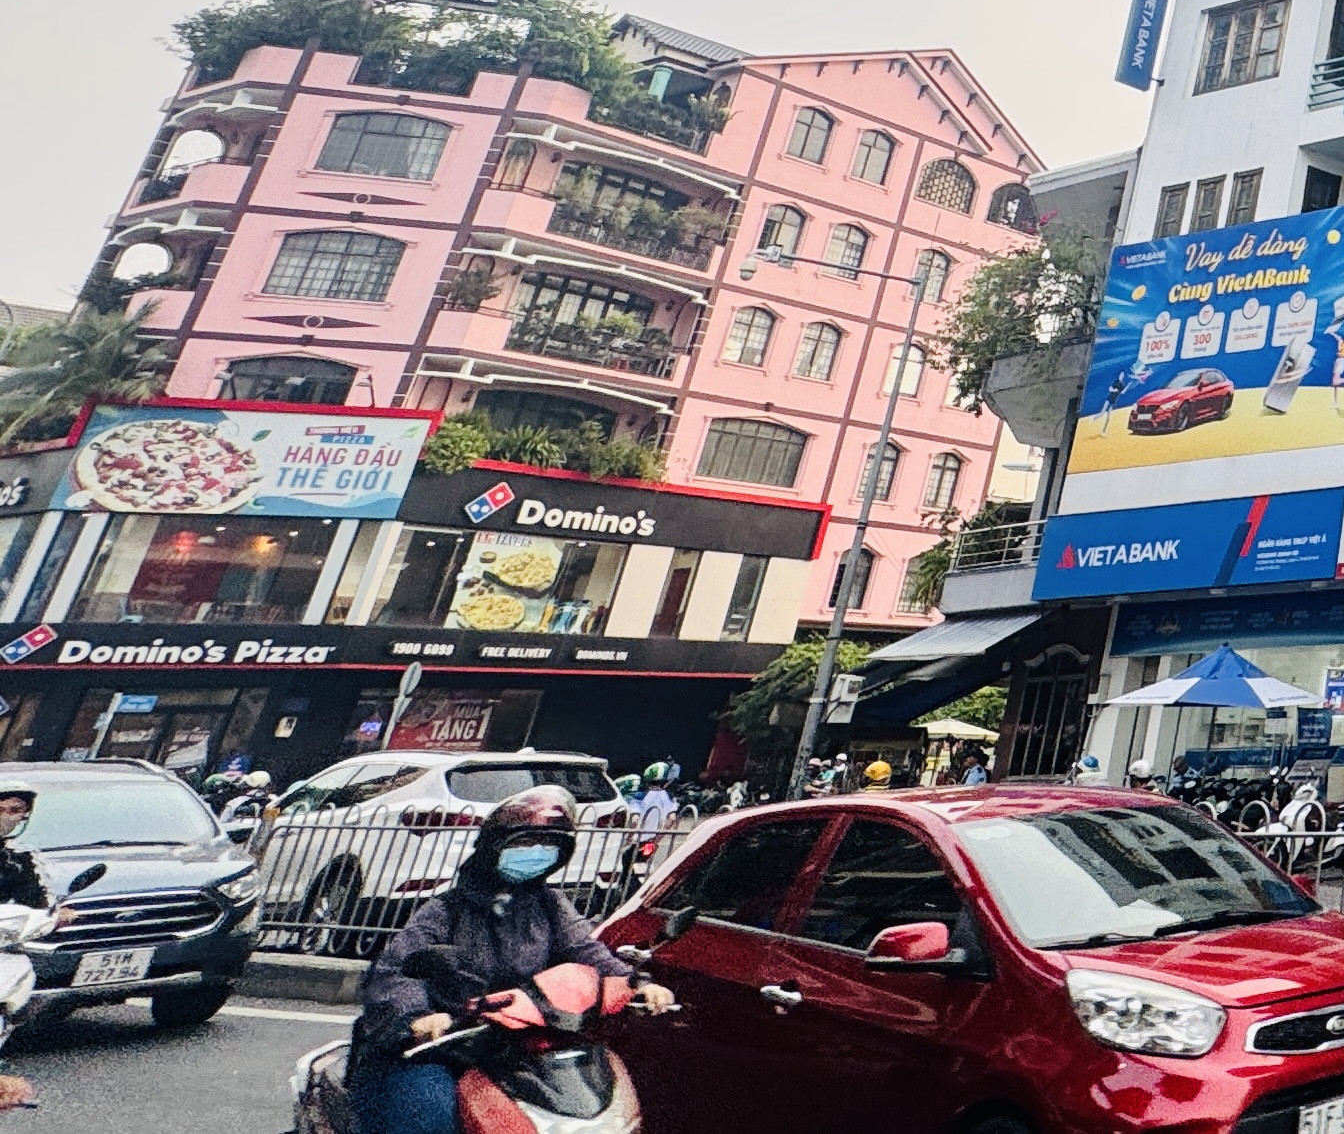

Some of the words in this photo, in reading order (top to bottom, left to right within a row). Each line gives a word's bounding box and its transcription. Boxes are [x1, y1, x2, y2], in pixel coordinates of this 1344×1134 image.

[1186, 243, 1224, 272] Vay
[1228, 233, 1254, 261] dễ
[1256, 228, 1309, 261] dàng
[1168, 279, 1212, 304] Cùng
[1216, 265, 1311, 296] VietABank
[1145, 339, 1170, 353] 100%
[1193, 333, 1212, 346] 300
[283, 442, 349, 466] HÀNG
[353, 442, 403, 466] ĐẦU
[277, 463, 328, 489] THẾ
[336, 464, 393, 491] GIỚI
[516, 498, 656, 537] Domino's
[58, 640, 228, 664] Domino's
[234, 639, 331, 663] Pizza
[481, 646, 506, 657] FREE
[507, 647, 552, 658] DELIVERY
